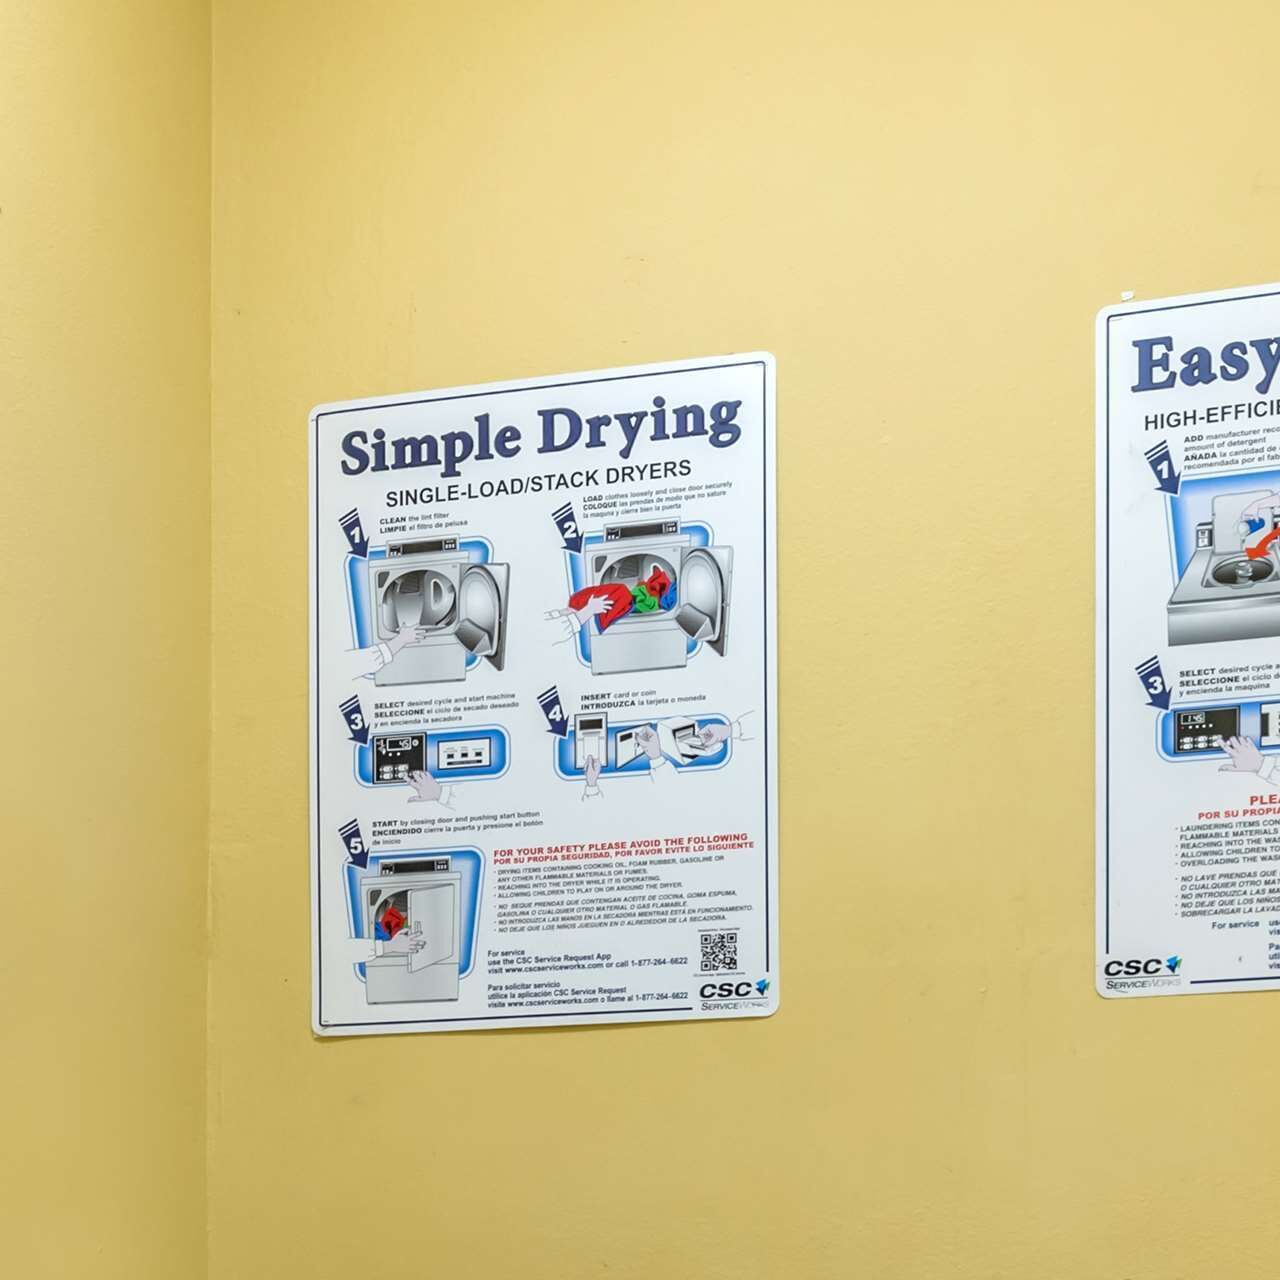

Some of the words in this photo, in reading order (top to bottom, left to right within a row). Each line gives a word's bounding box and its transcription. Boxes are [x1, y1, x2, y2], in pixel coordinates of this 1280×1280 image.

[340, 412, 521, 478] Simple
[536, 395, 741, 459] Drying
[1183, 434, 1204, 443] ADD
[1205, 428, 1260, 440] manufacturer
[1156, 459, 1168, 480] 1
[385, 469, 599, 507] SINGLE-LOAD/STACK
[606, 459, 691, 484] DRYERS
[379, 516, 406, 525] CLEAN
[562, 520, 578, 539] 2
[350, 525, 361, 544] 1
[1146, 674, 1163, 695] 3
[349, 712, 363, 731] 3
[547, 703, 562, 723] 4
[1198, 810, 1220, 820] POR
[1223, 809, 1239, 818] SU
[349, 837, 363, 854] 5
[493, 848, 513, 857] FOR
[516, 846, 544, 856] YOUR
[546, 844, 585, 854] SAFETY
[588, 841, 626, 851] PLEASE
[629, 839, 660, 848] AVOID
[663, 837, 684, 846] THE
[687, 832, 748, 844] FOLLOWING
[1211, 921, 1226, 929] For
[1228, 920, 1260, 929] service
[515, 956, 532, 964] CSC
[534, 955, 562, 963] Service
[563, 953, 594, 962] Request
[595, 952, 611, 961] App
[615, 959, 629, 968] call
[1104, 958, 1162, 976] CSC
[699, 981, 752, 998] CSC
